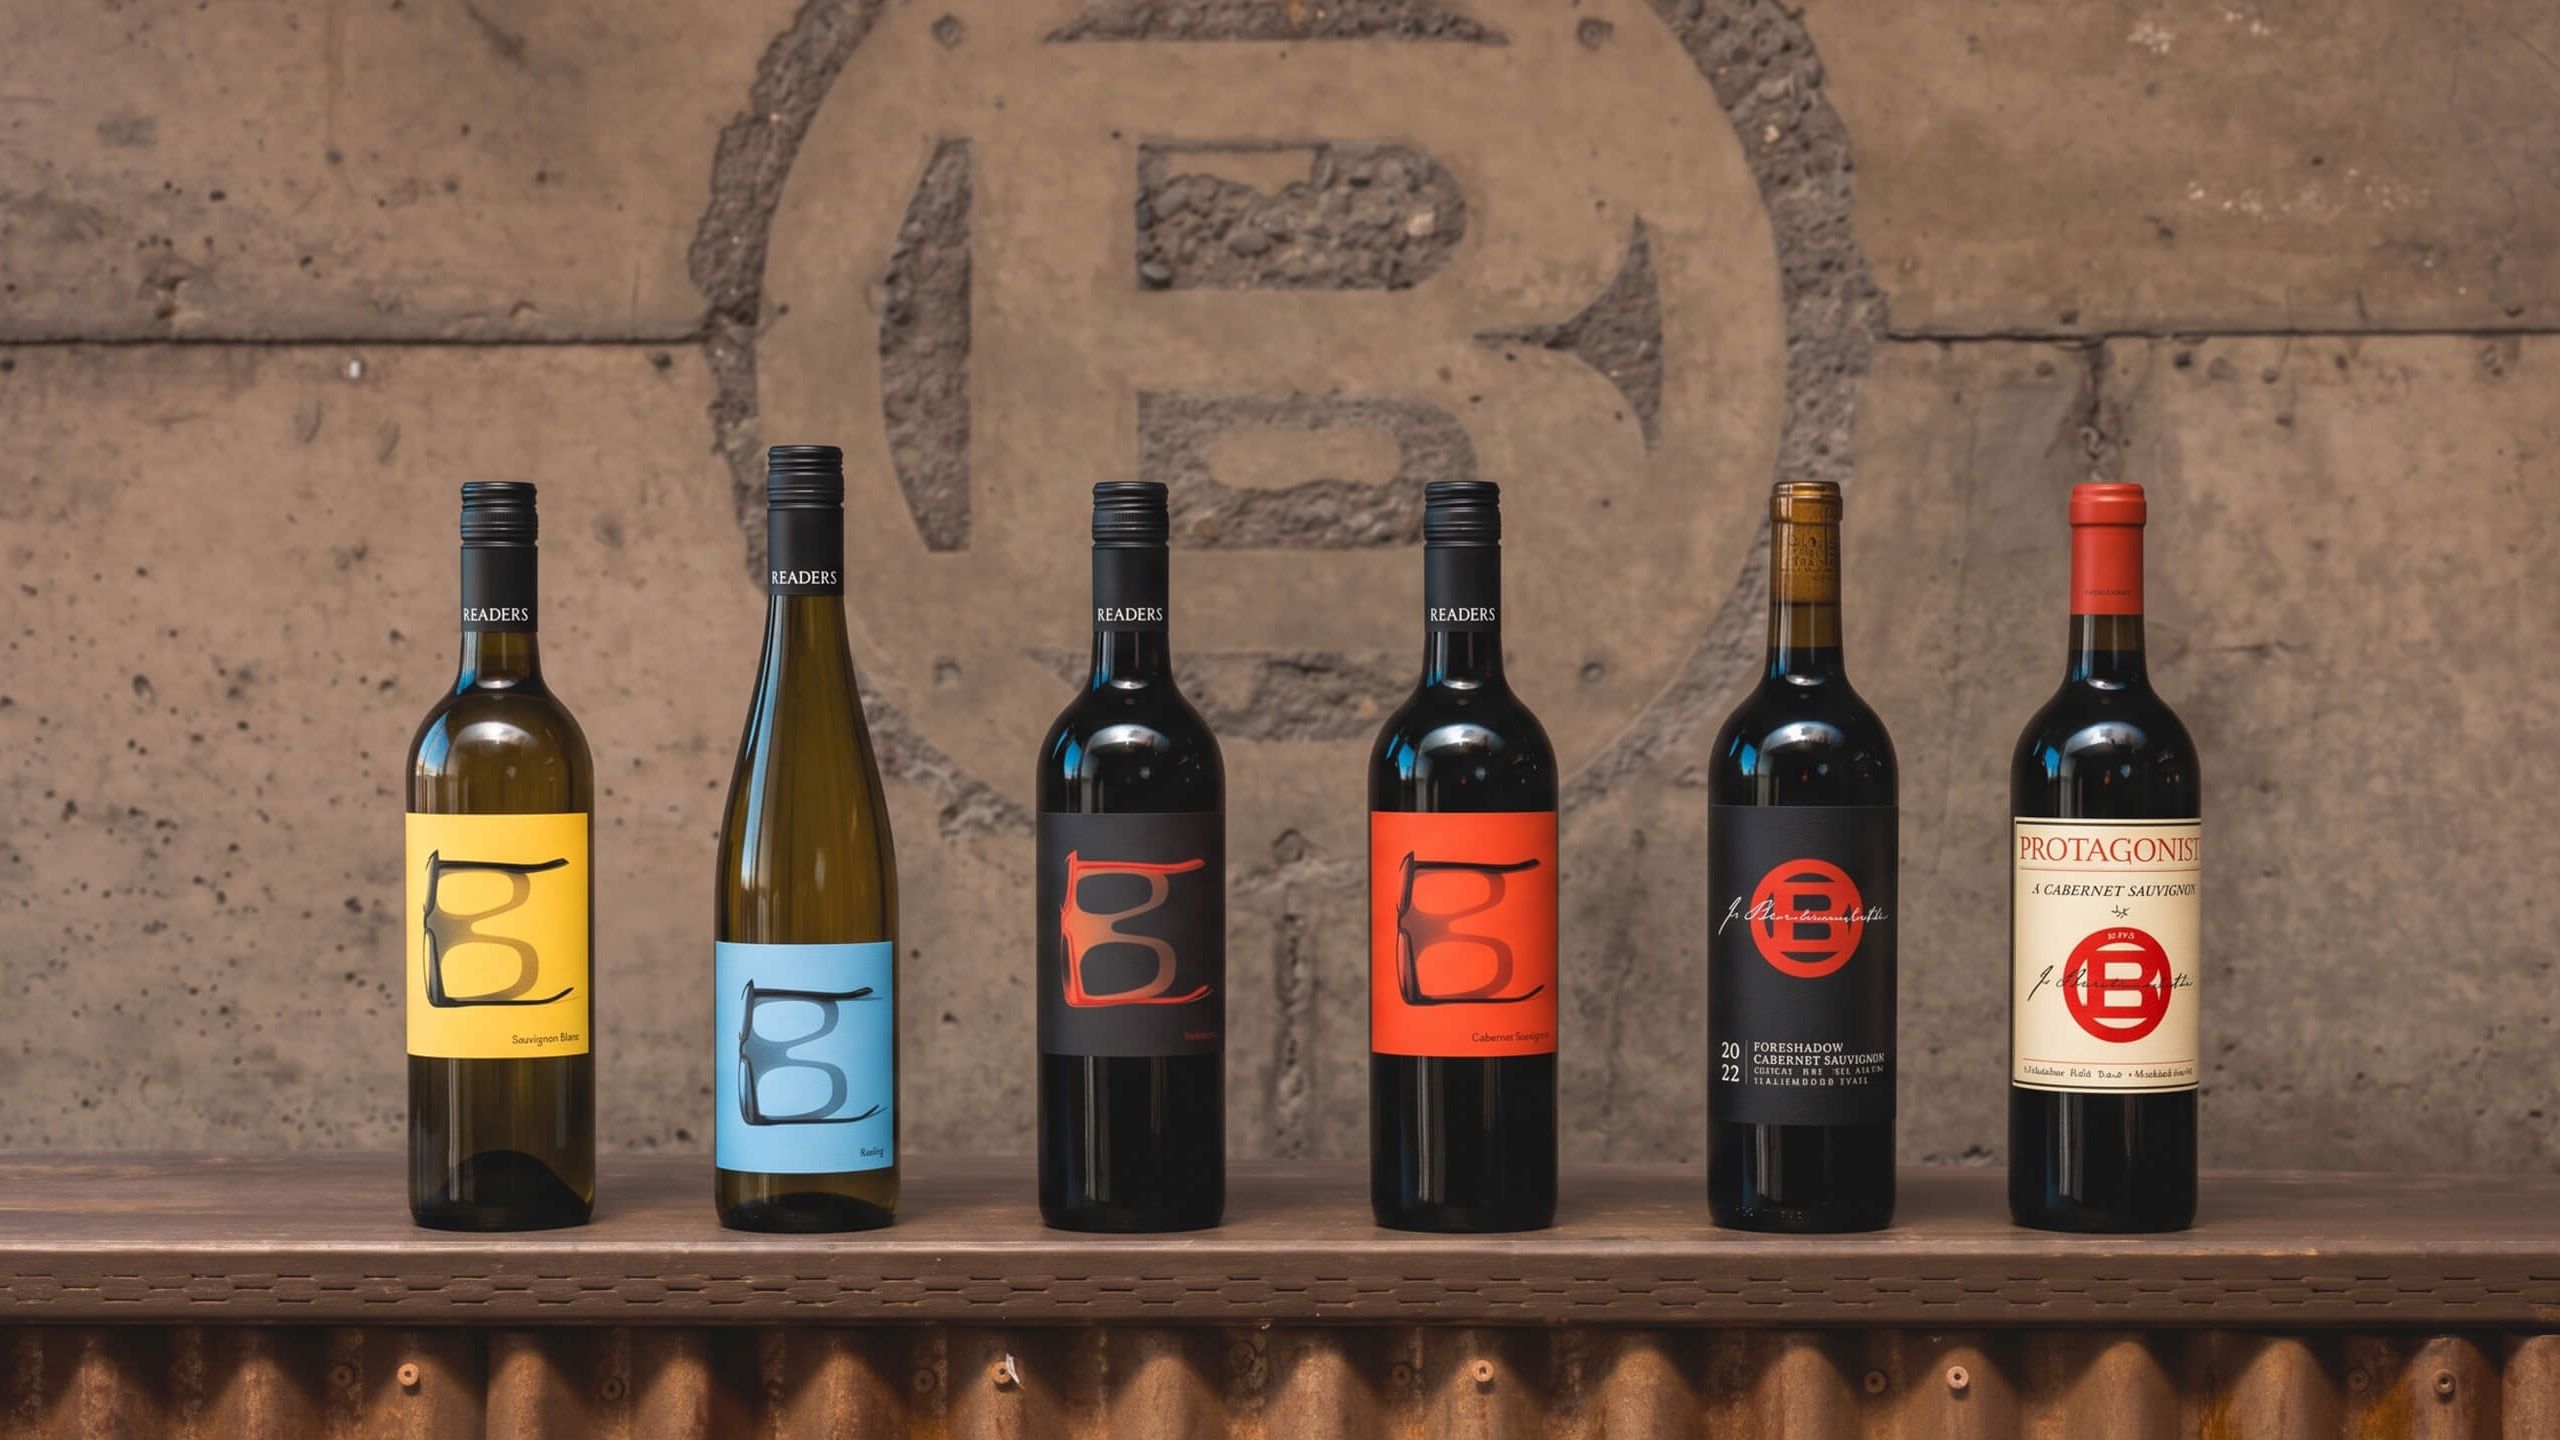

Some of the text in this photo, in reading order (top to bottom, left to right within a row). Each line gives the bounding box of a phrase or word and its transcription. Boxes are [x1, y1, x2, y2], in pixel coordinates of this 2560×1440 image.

[771, 571, 838, 585] READERS
[463, 608, 529, 621] READERS
[1097, 607, 1163, 622] READERS
[1430, 607, 1496, 622] READERS
[2020, 836, 2200, 865] PROTAGONIST
[2044, 883, 2125, 897] CABERNET
[2128, 883, 2196, 897] SAUVIGNON
[512, 1034, 559, 1047] Sauvignon
[1471, 1032, 1514, 1042] Cabernet
[1721, 1041, 1740, 1059] 20
[1753, 1041, 1843, 1053] FORESHADOW
[1753, 1054, 1821, 1066] CABERNET
[1721, 1064, 1740, 1082] 22
